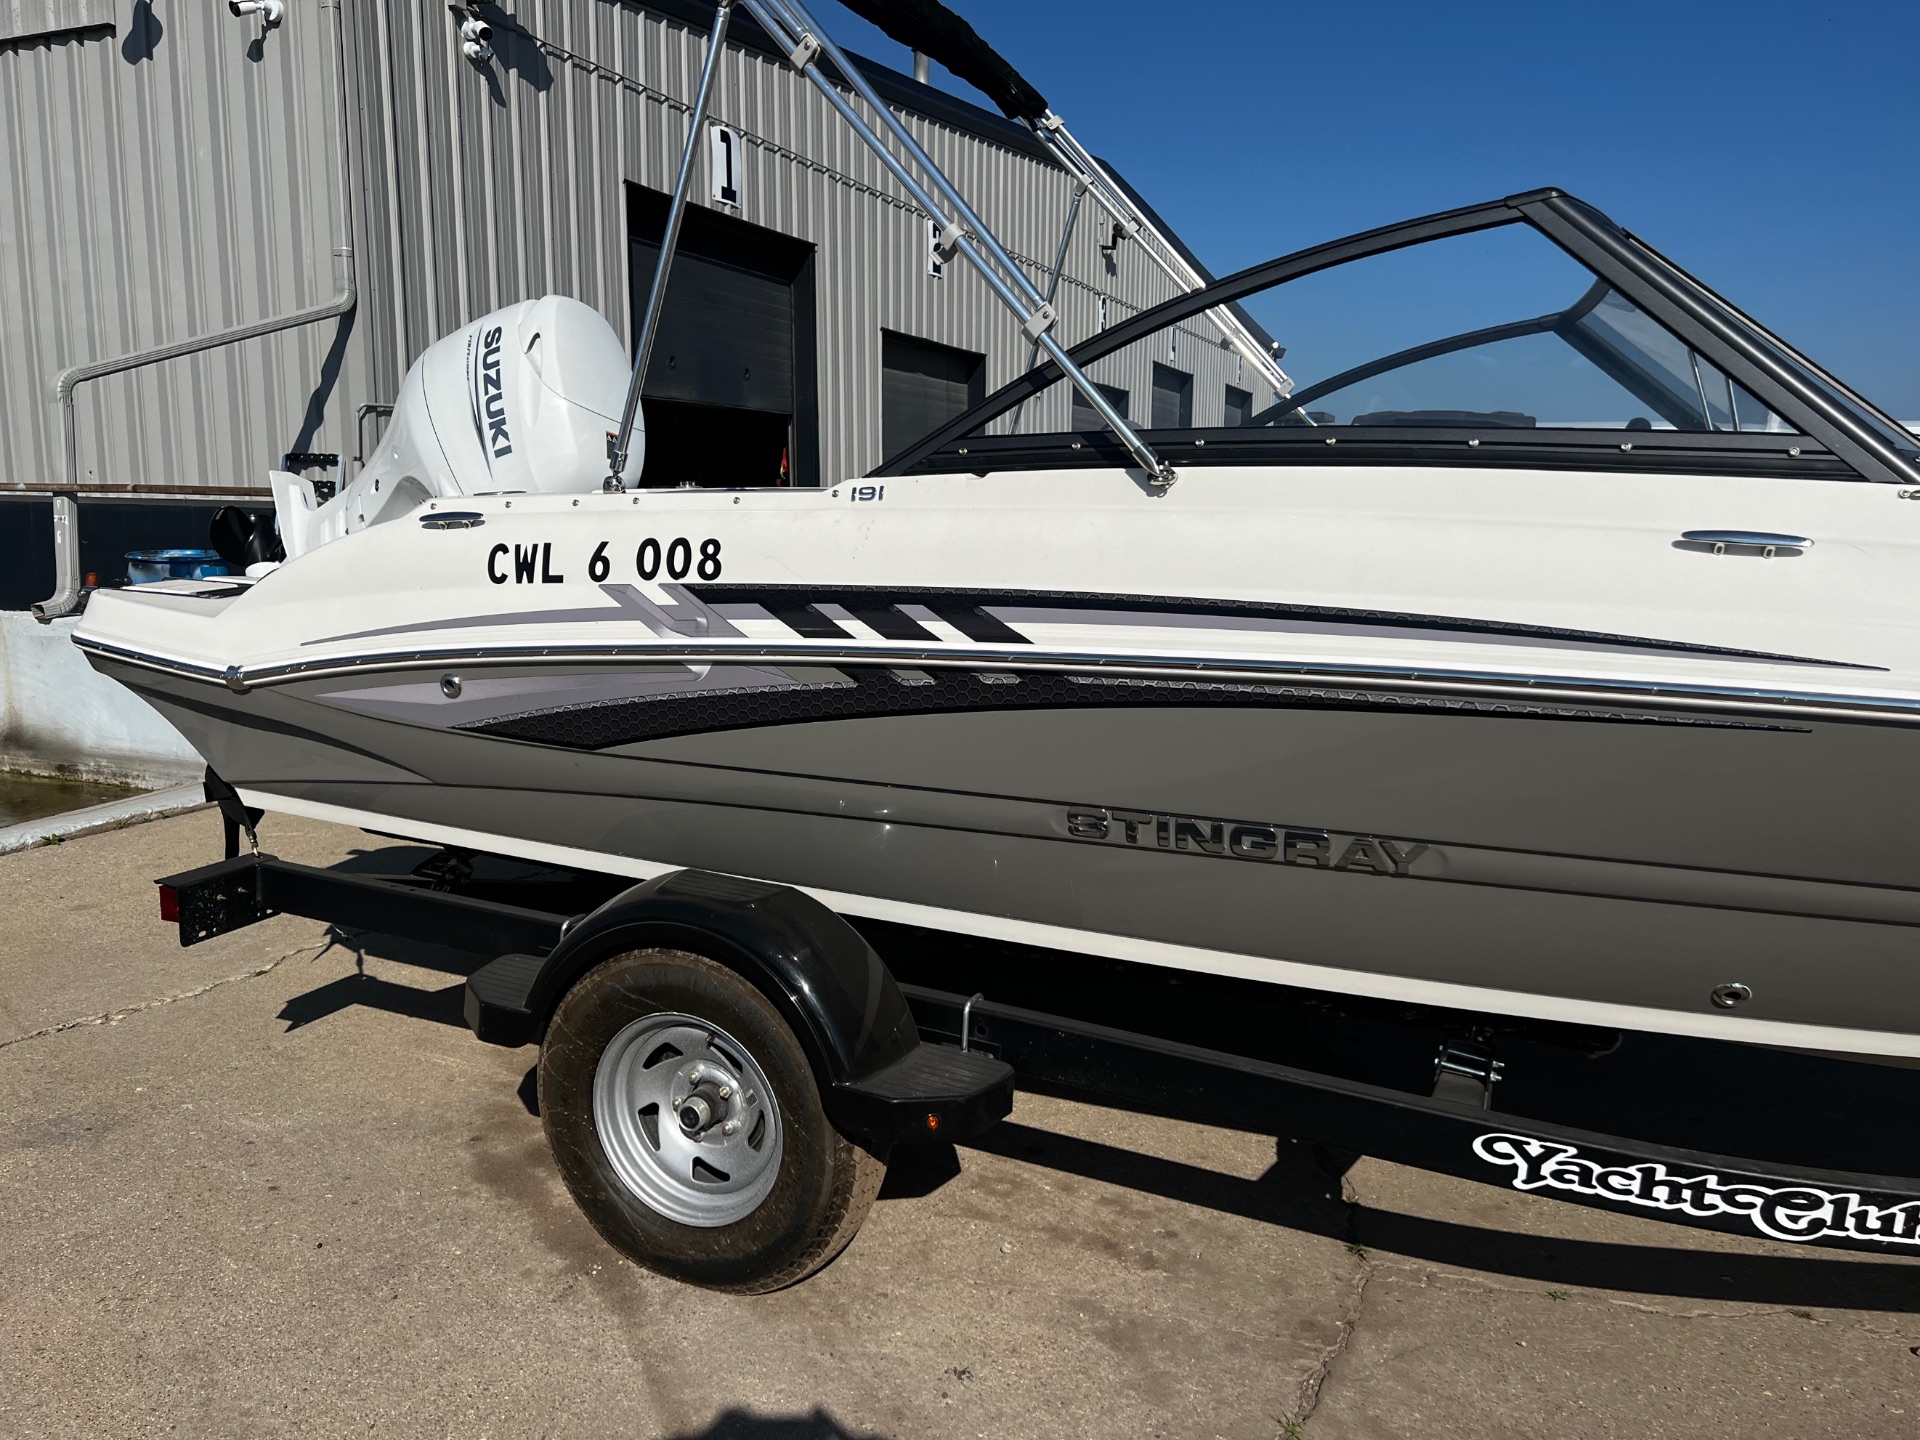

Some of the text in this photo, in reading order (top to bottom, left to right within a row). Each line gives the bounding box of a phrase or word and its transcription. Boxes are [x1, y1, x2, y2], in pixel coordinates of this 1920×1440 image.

[720, 128, 737, 203] 1
[482, 326, 513, 459] SUZUKI
[851, 485, 884, 502] 191
[488, 537, 722, 585] CWL 6 008
[1067, 805, 1431, 875] STINGRAY
